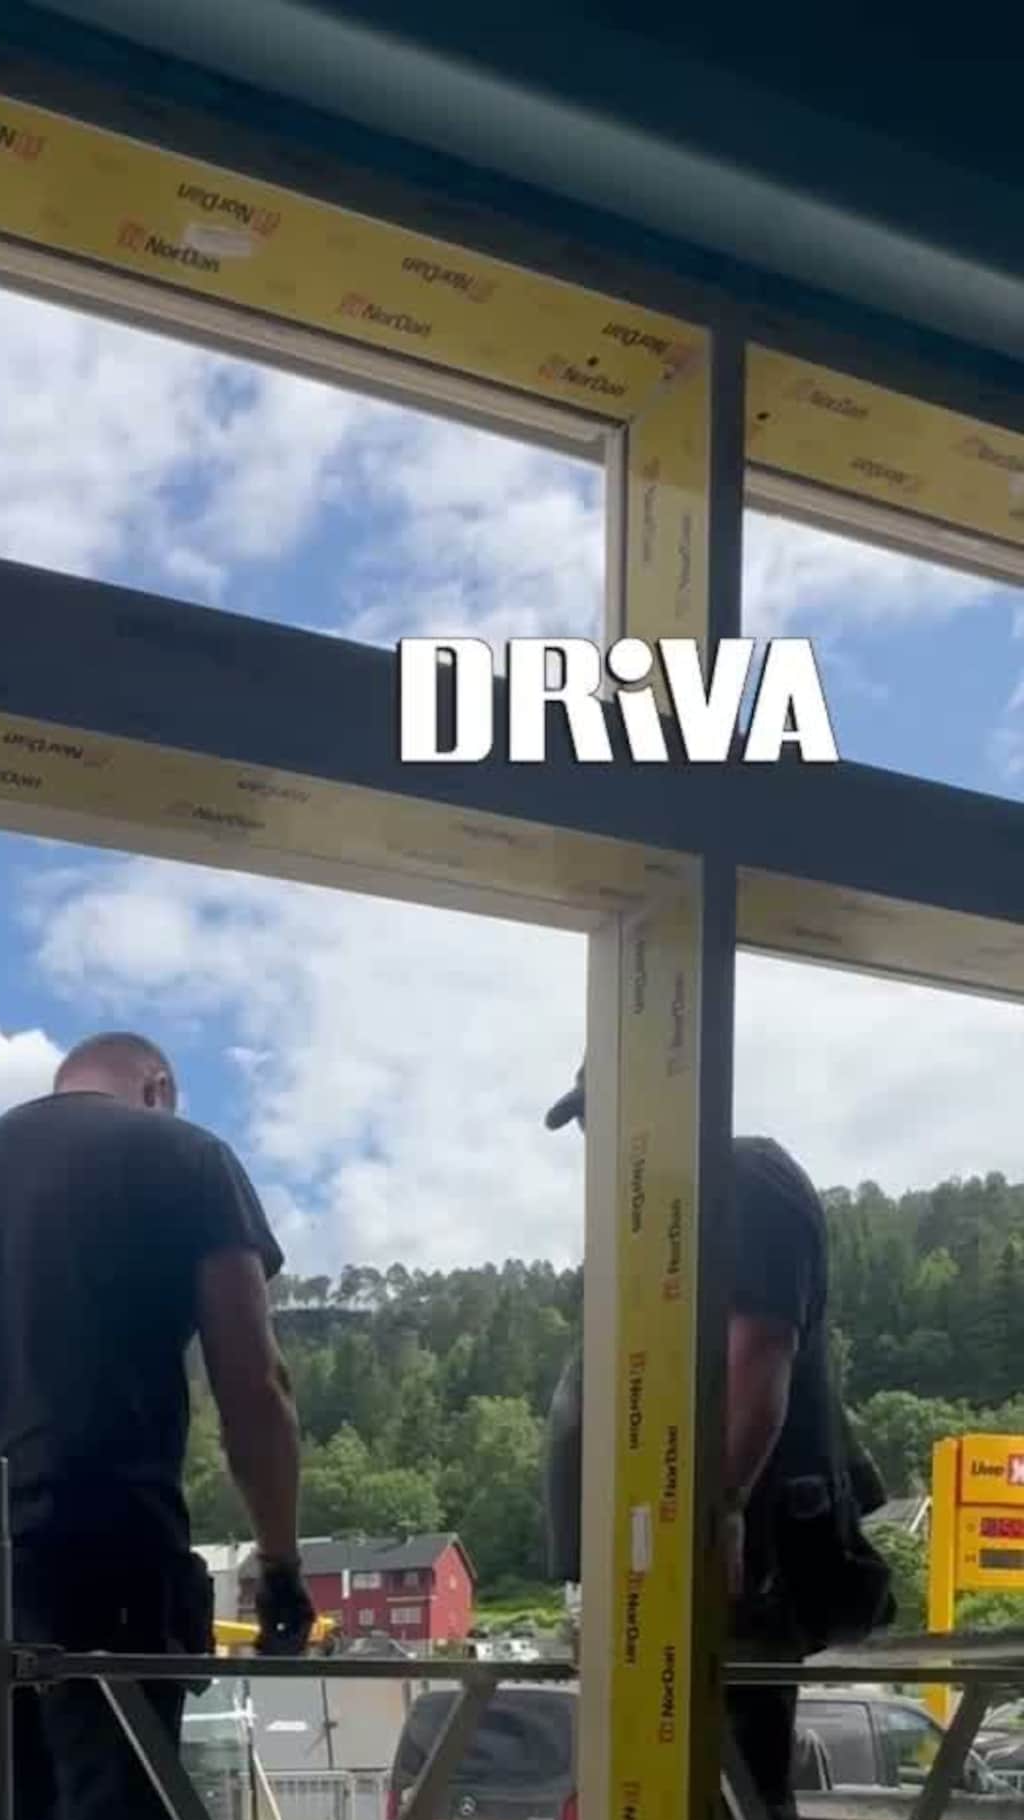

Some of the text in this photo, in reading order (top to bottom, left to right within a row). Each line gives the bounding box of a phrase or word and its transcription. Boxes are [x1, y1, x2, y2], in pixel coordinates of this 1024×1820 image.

[177, 182, 256, 226] NorDan
[144, 233, 221, 274] NorDan
[362, 300, 432, 338] NorDan
[628, 1376, 643, 1451] NorDan
[625, 1590, 640, 1665] NorDan
[661, 1644, 676, 1719] NorDan
